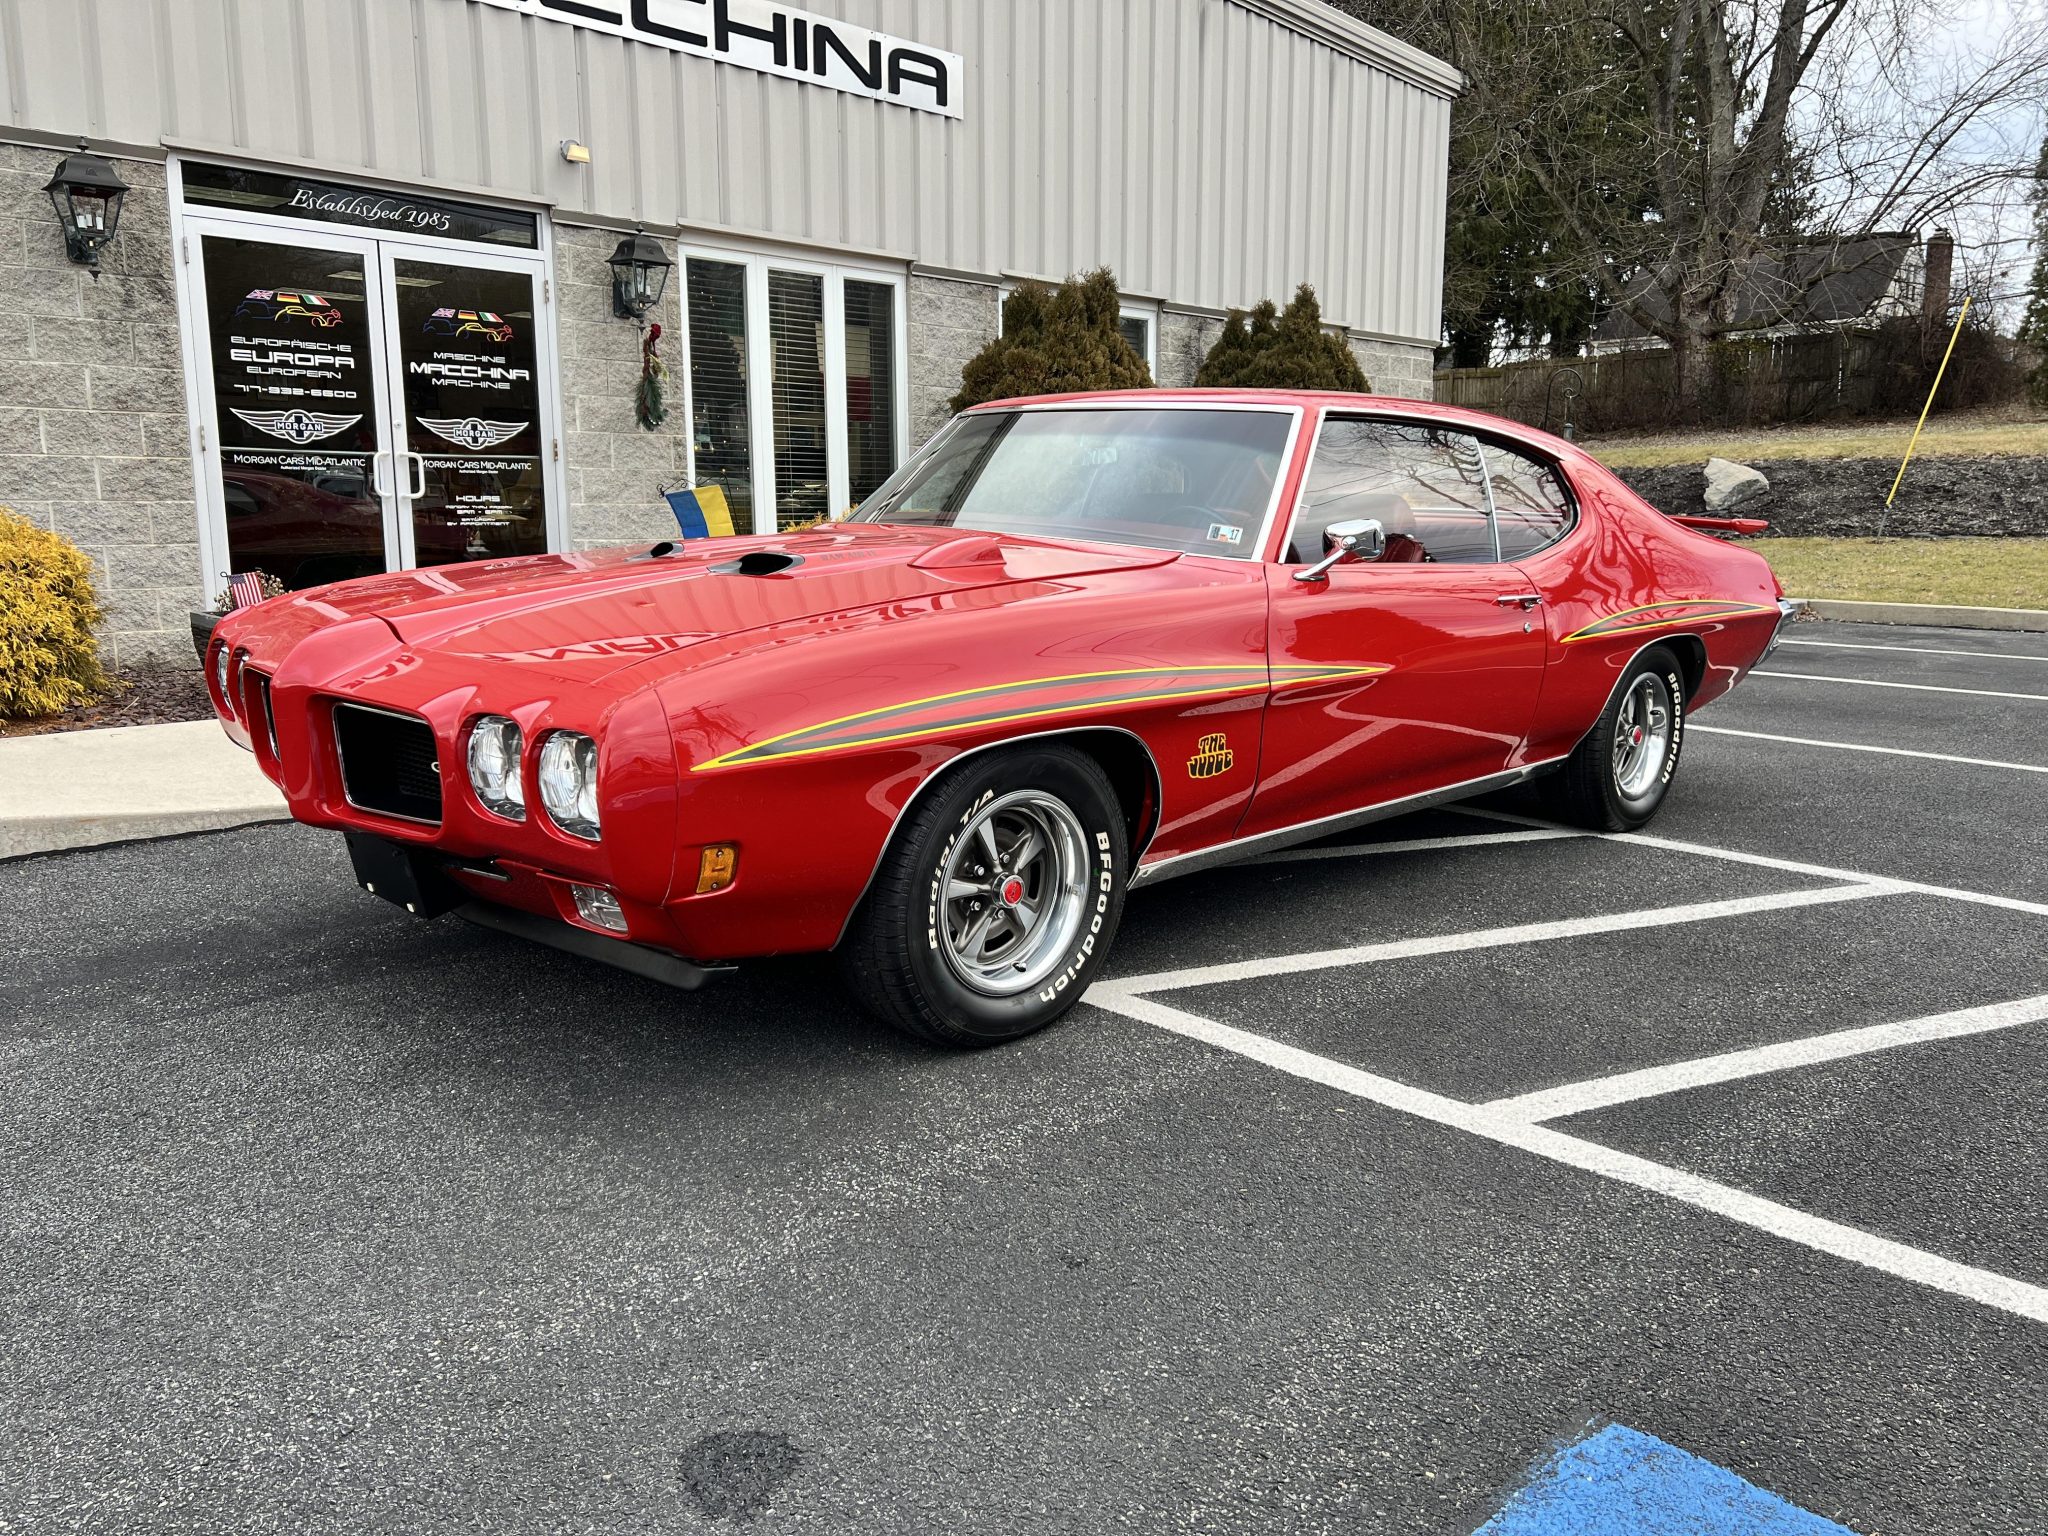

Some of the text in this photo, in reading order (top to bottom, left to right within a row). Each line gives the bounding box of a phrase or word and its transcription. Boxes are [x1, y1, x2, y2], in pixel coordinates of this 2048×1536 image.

[288, 188, 450, 231] Established 1985
[230, 335, 352, 353] EUROPÄISCHE
[230, 348, 355, 369] EUROPA
[433, 351, 506, 364] MASCHINE
[246, 365, 342, 380] EUROPEAN
[410, 361, 530, 381] MACCHINA
[233, 383, 357, 399] 717-932-6600
[431, 378, 511, 390] MACHINE
[276, 421, 322, 432] MORGAN
[455, 429, 495, 438] MORGAN
[233, 454, 366, 467] MORGAN CARS MID-ATLANTIC
[457, 460, 480, 470] CARS
[480, 460, 532, 470] MID-ATLANTIC
[455, 495, 501, 503] HOURS
[1229, 528, 1240, 541] 17
[1661, 672, 1681, 784] BFGoodrich
[1198, 733, 1226, 755] THE
[1187, 749, 1233, 778] JUDGE
[928, 788, 995, 950] Radial T/A
[1039, 831, 1113, 1003] BFGoodrich
